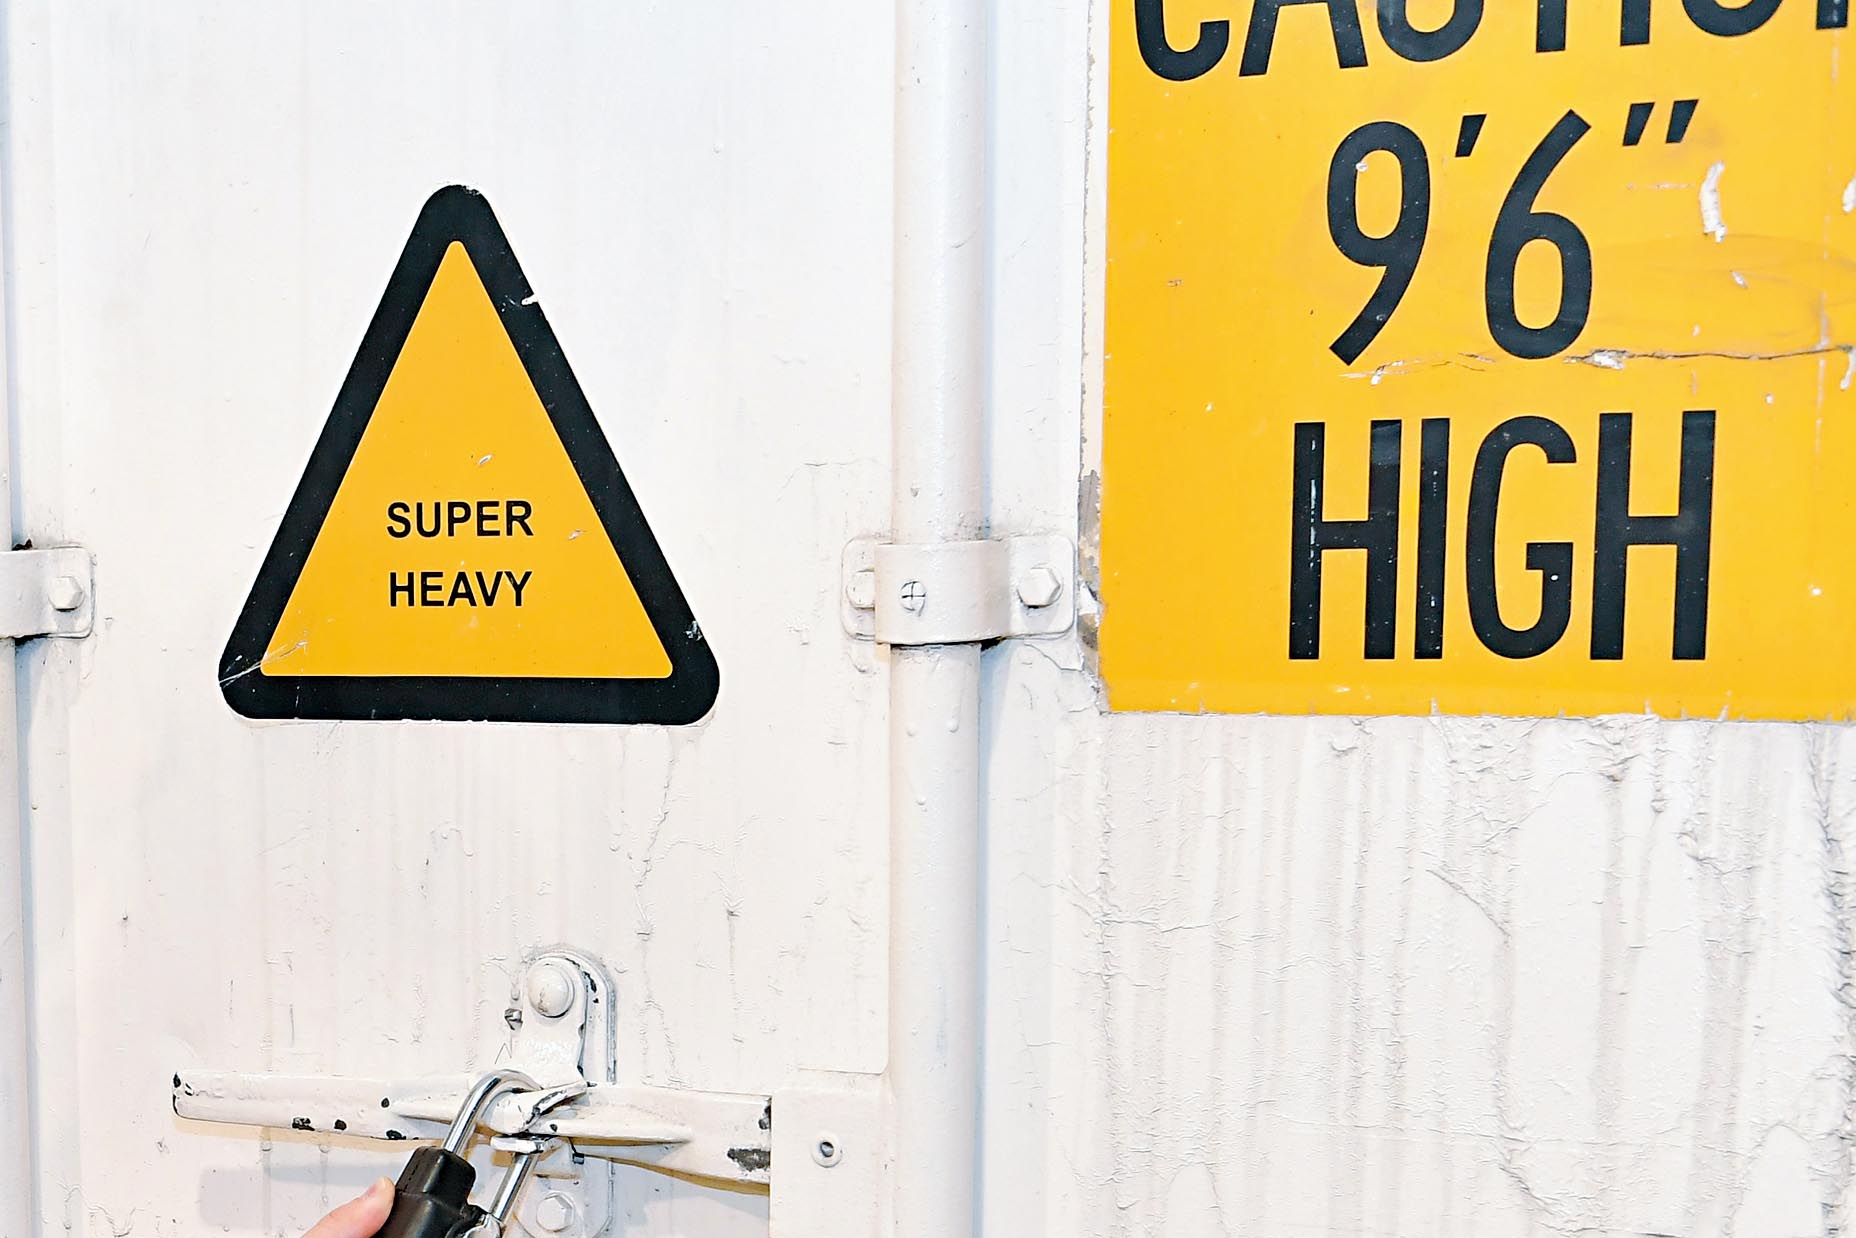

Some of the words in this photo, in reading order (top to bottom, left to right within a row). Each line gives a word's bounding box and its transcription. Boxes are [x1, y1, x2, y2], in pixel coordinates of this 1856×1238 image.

[386, 500, 534, 538] SUPER
[1288, 410, 1717, 660] HIGH
[388, 570, 533, 608] HEAVY
